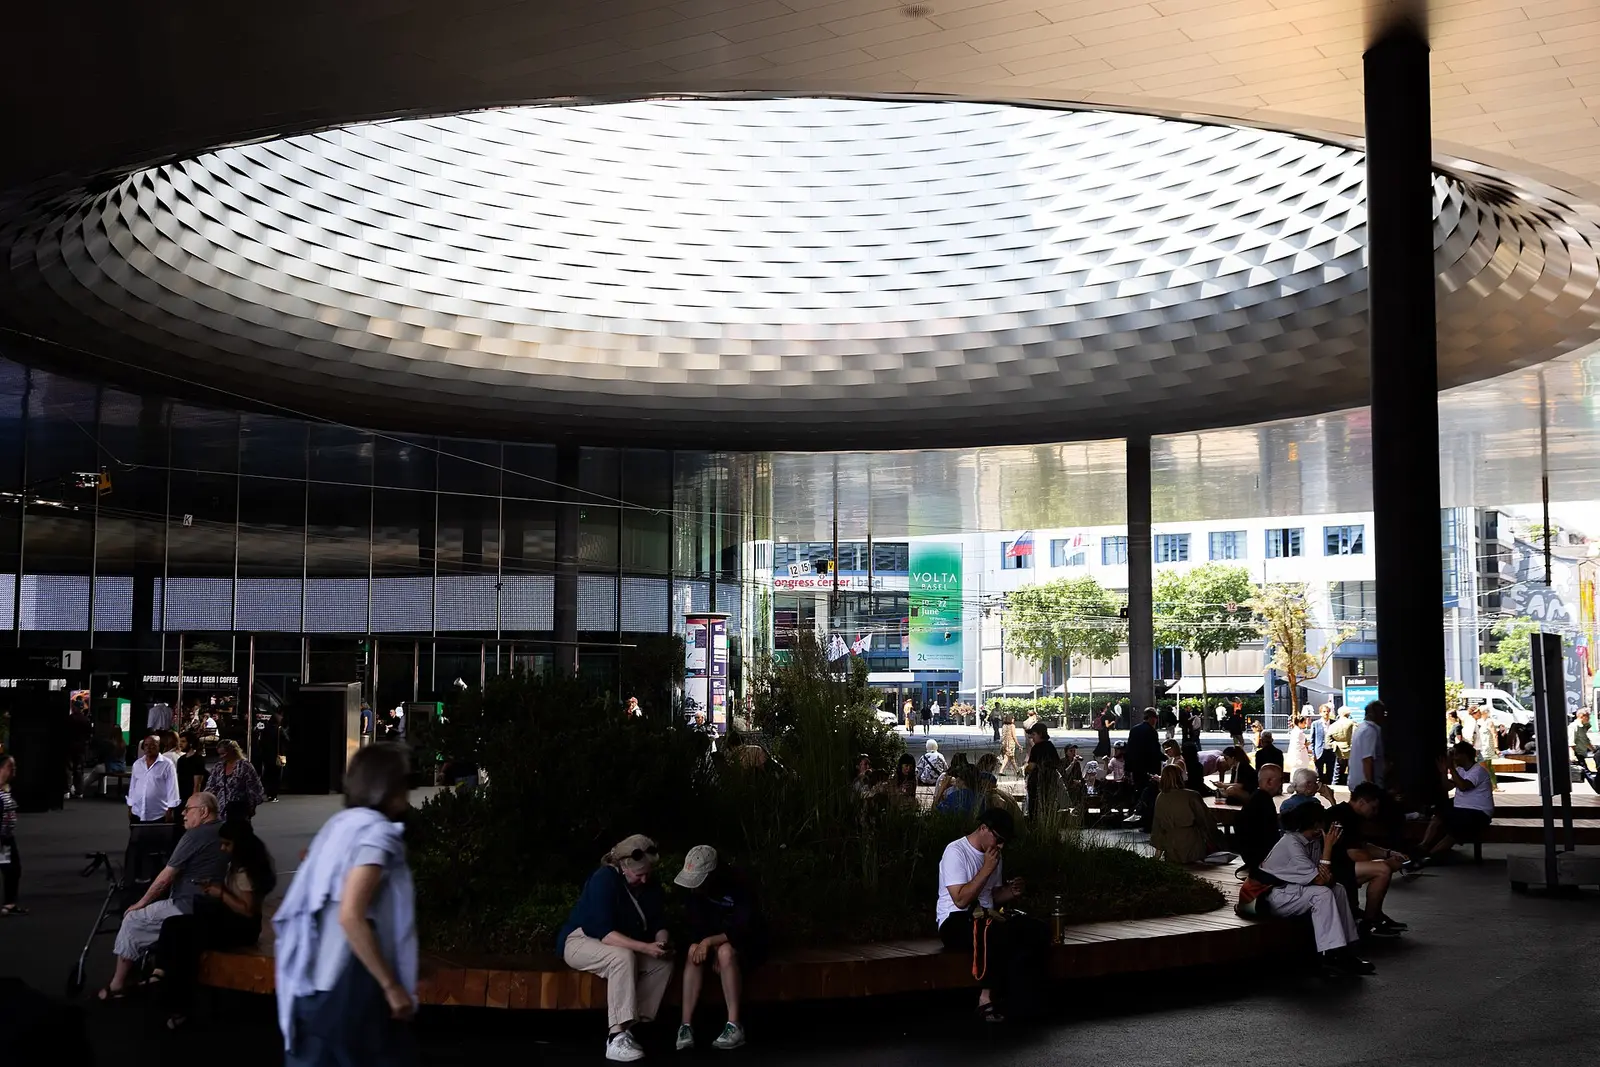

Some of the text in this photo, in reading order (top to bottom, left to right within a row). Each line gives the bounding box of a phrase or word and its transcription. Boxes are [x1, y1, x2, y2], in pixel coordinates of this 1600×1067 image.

[790, 566, 798, 575] 12
[913, 573, 957, 582] VOLTA
[774, 579, 814, 589] ongress
[857, 577, 883, 587] bael
[922, 608, 939, 616] June
[65, 653, 71, 668] 1
[143, 675, 165, 683] APERITIF
[170, 676, 197, 684] COCTAILS
